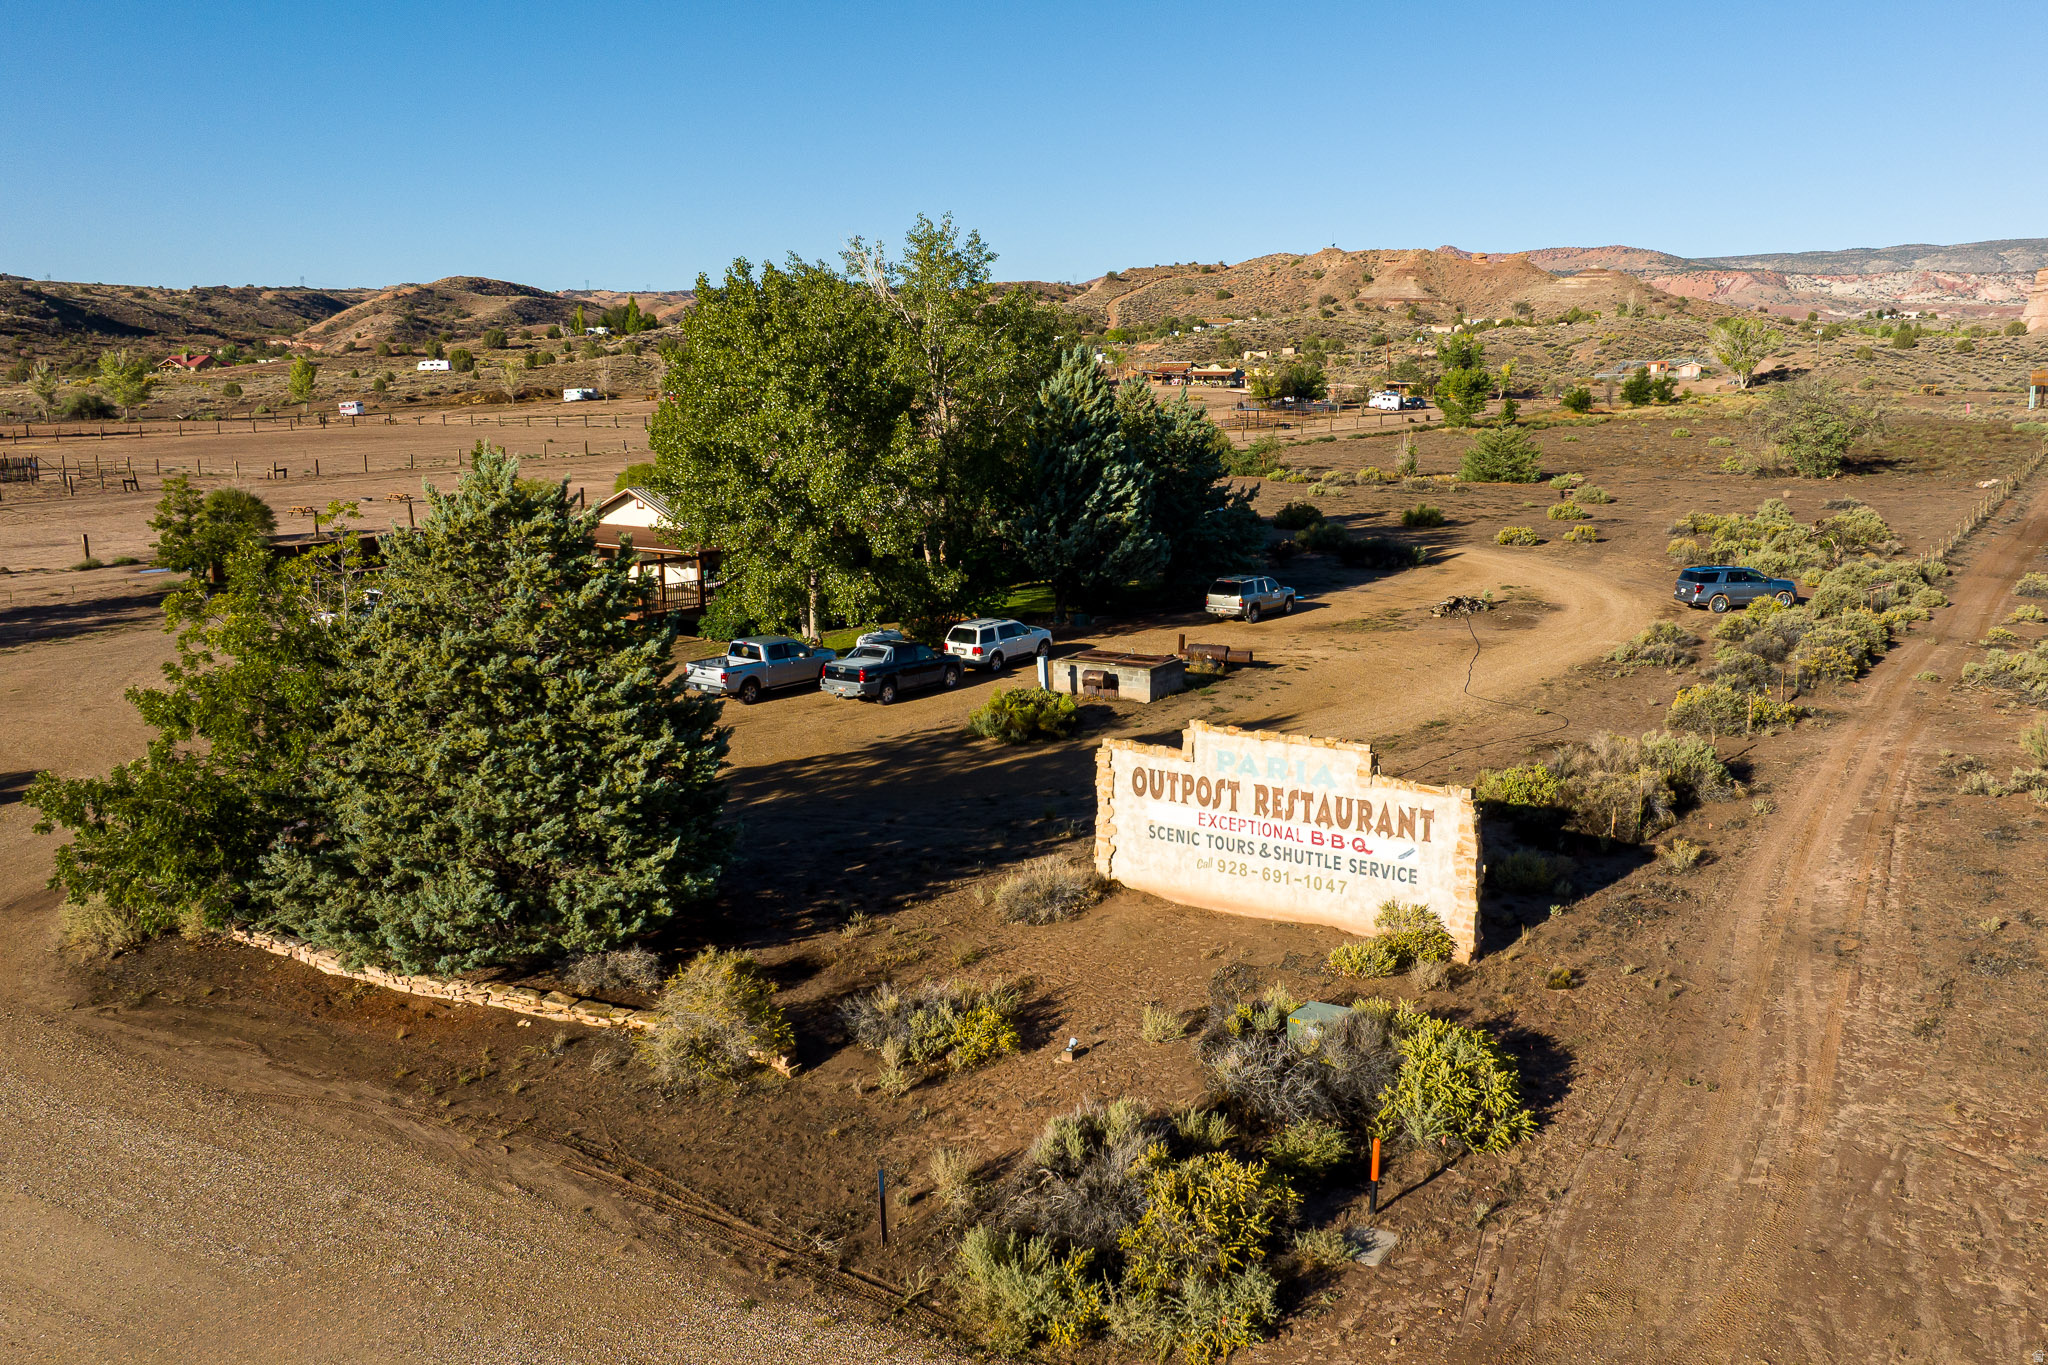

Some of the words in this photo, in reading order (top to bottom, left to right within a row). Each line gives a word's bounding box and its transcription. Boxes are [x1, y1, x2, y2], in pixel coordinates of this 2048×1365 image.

[1215, 749, 1338, 788] PARIA
[1132, 766, 1241, 812] OUTPOST
[1253, 784, 1435, 842] RESTAURANT
[1198, 812, 1304, 843] EXCEPTIONAL
[1148, 824, 1200, 846] SCENIC
[1206, 833, 1255, 855] TOURS
[1349, 858, 1418, 884] SERVICE
[1196, 857, 1214, 869] Call
